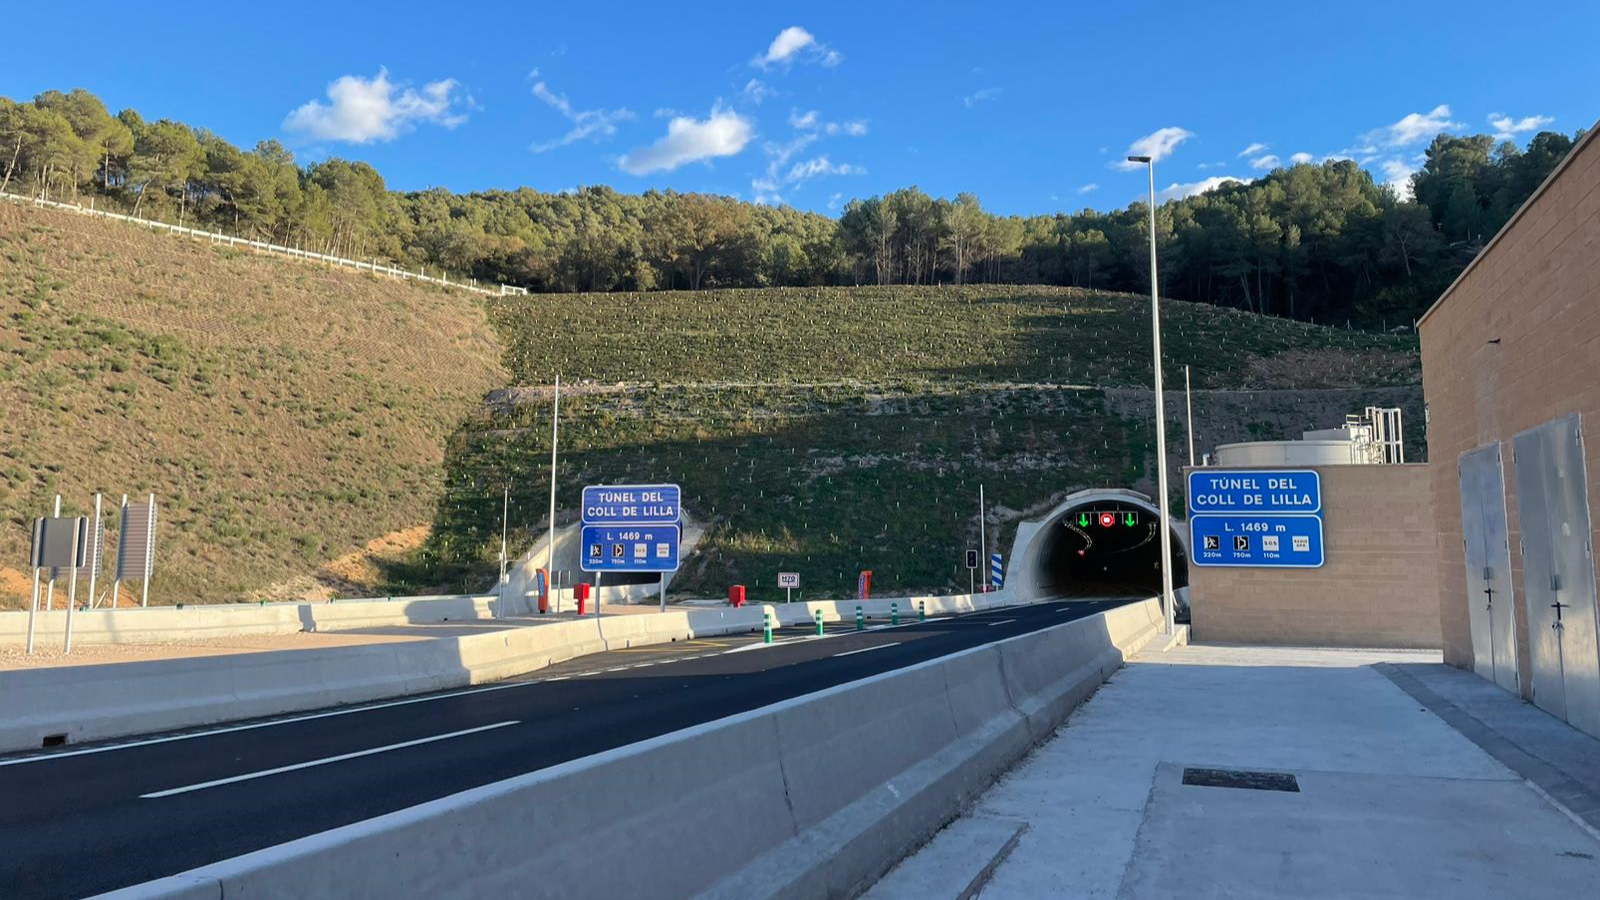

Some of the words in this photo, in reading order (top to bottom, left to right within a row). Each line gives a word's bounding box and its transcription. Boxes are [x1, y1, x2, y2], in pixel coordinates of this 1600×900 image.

[1210, 477, 1260, 490] TÚNEL
[1268, 478, 1297, 490] DEL
[598, 491, 636, 503] TÚNEL
[642, 492, 663, 502] DEL
[1197, 494, 1235, 505] COLL
[1244, 494, 1263, 505] DE
[1271, 494, 1312, 505] LILLA
[587, 507, 616, 517] COLL
[623, 506, 637, 516] DE
[643, 506, 673, 516] LILLA
[1225, 523, 1234, 532] L.
[1241, 523, 1268, 532] 1469
[619, 532, 640, 540] 1469
